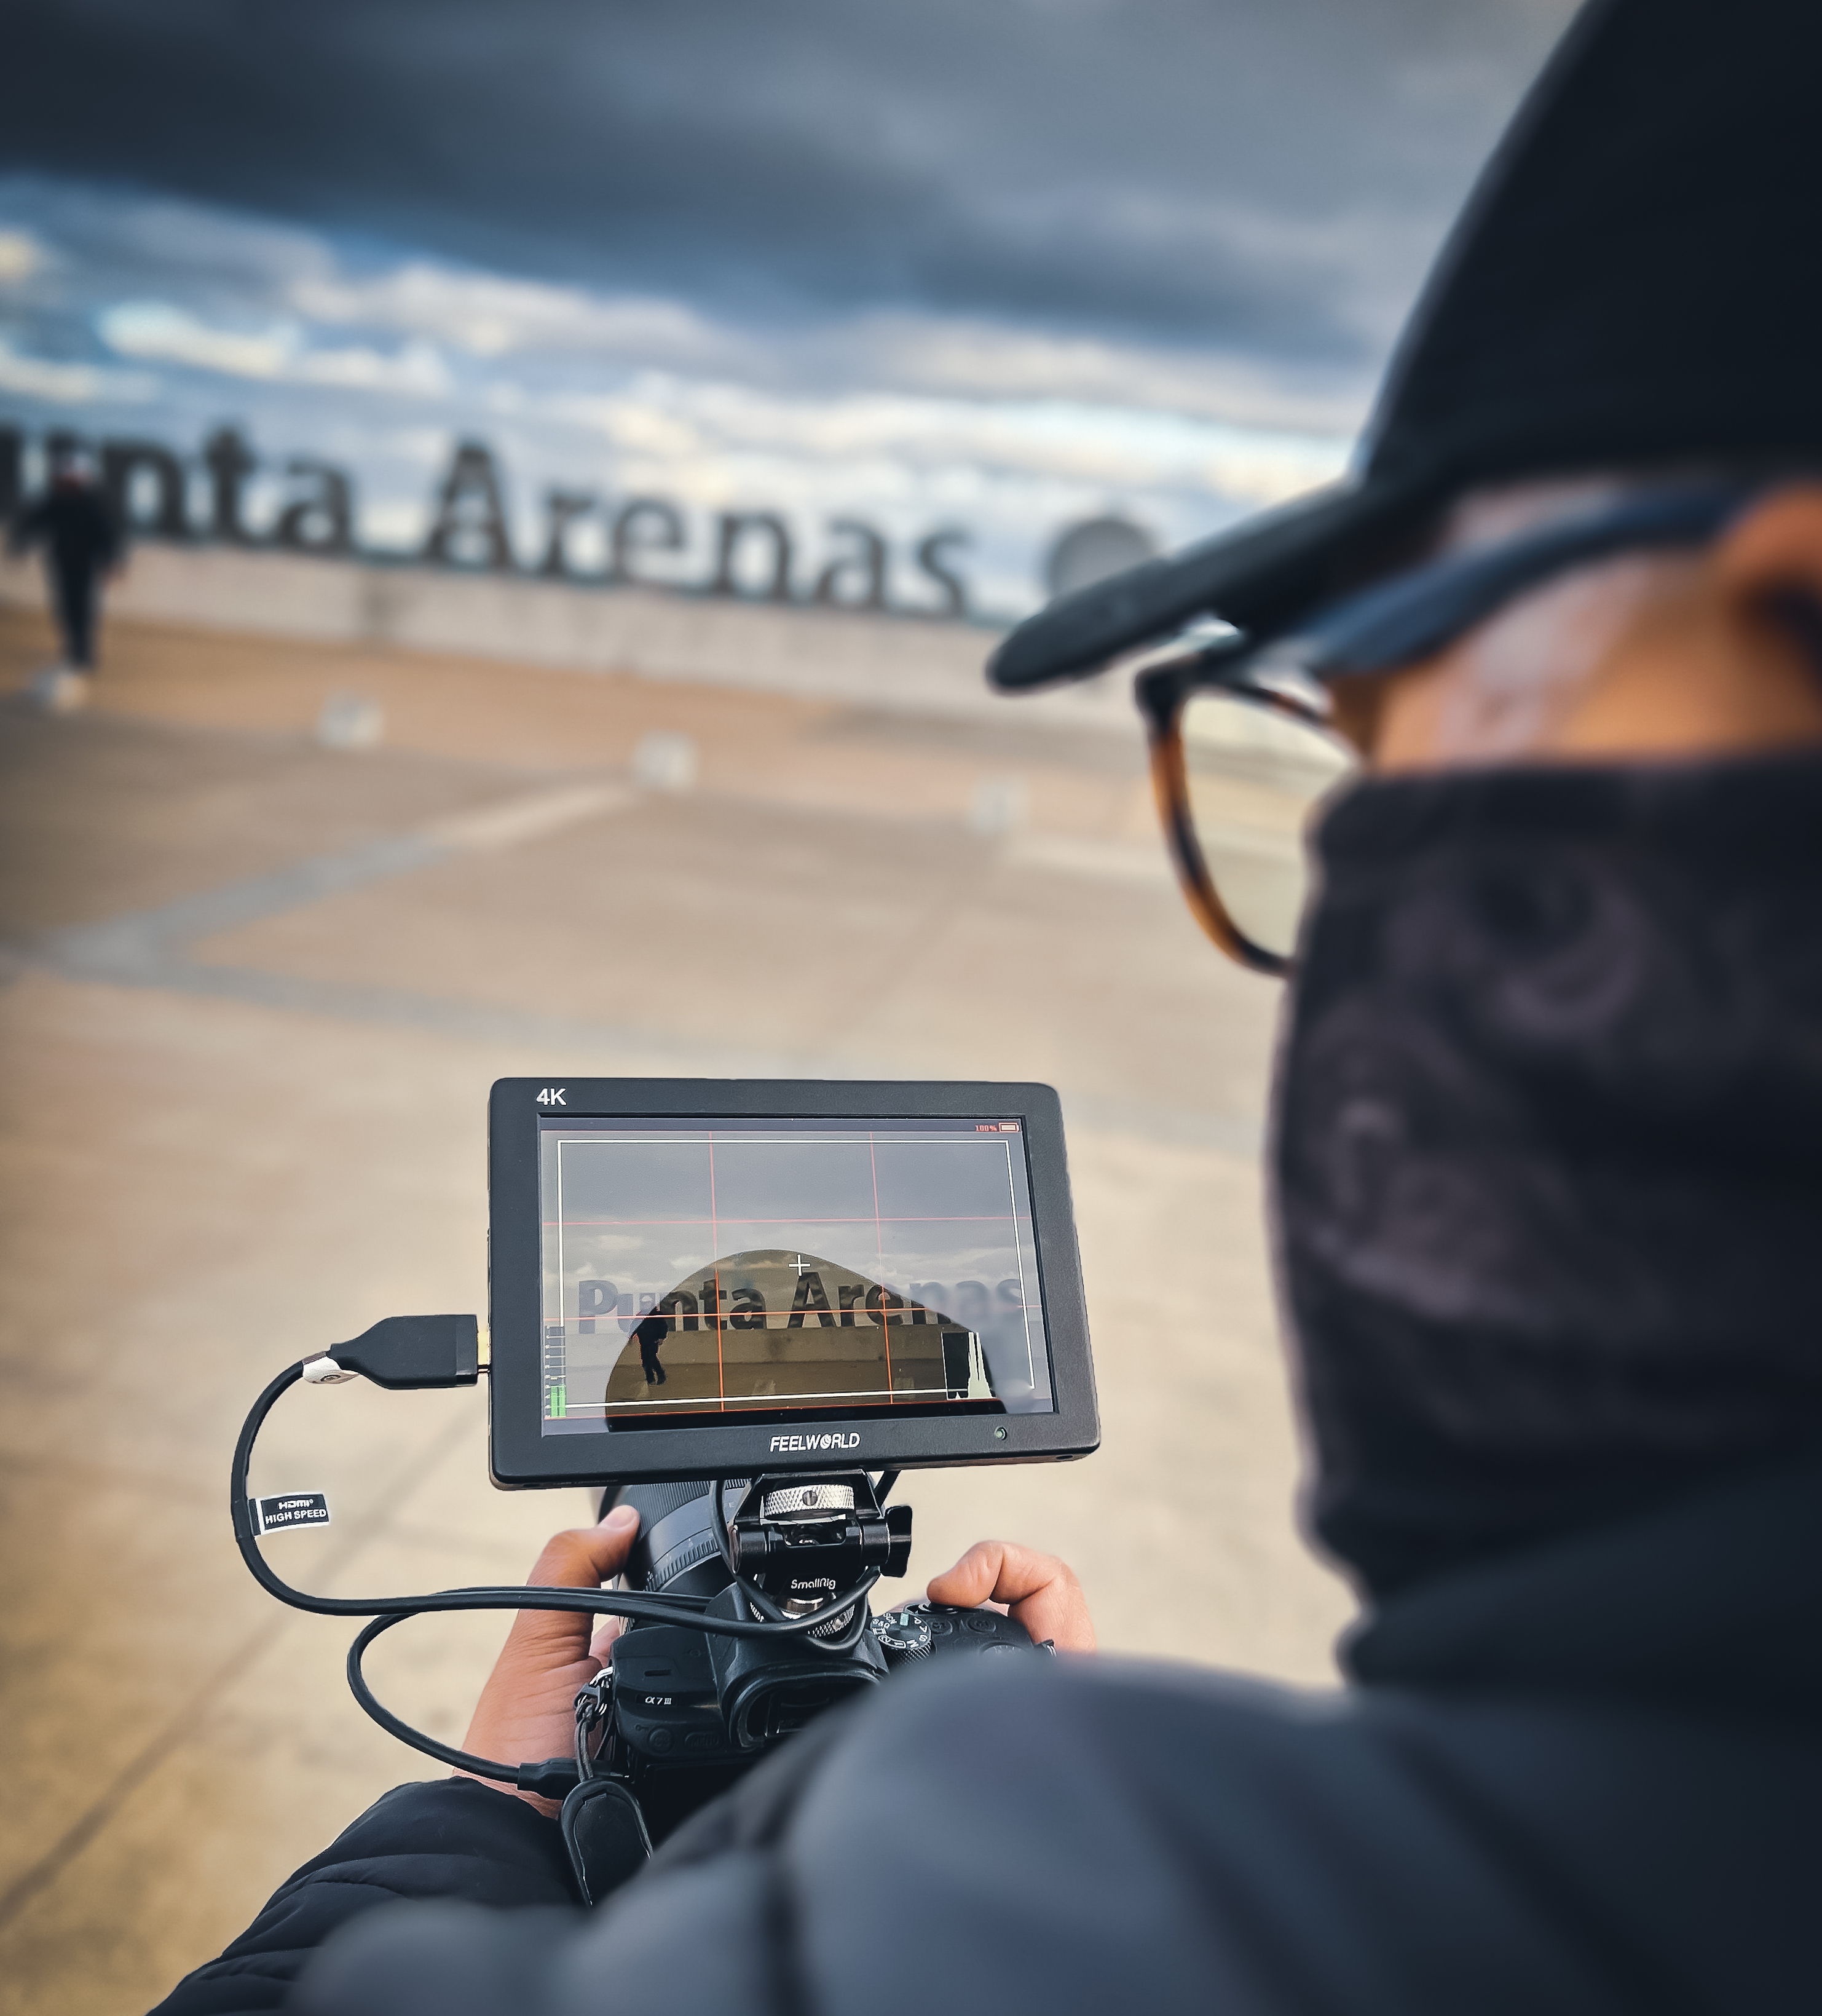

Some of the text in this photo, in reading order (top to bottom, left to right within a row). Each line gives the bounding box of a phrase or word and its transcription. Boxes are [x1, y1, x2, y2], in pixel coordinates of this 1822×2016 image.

[423, 439, 974, 612] Arenas
[536, 1088, 567, 1105] 4K
[770, 1433, 861, 1452] FEELWORLD
[265, 1509, 327, 1525] HIGH SPEED
[791, 1578, 836, 1590] SmallRig
